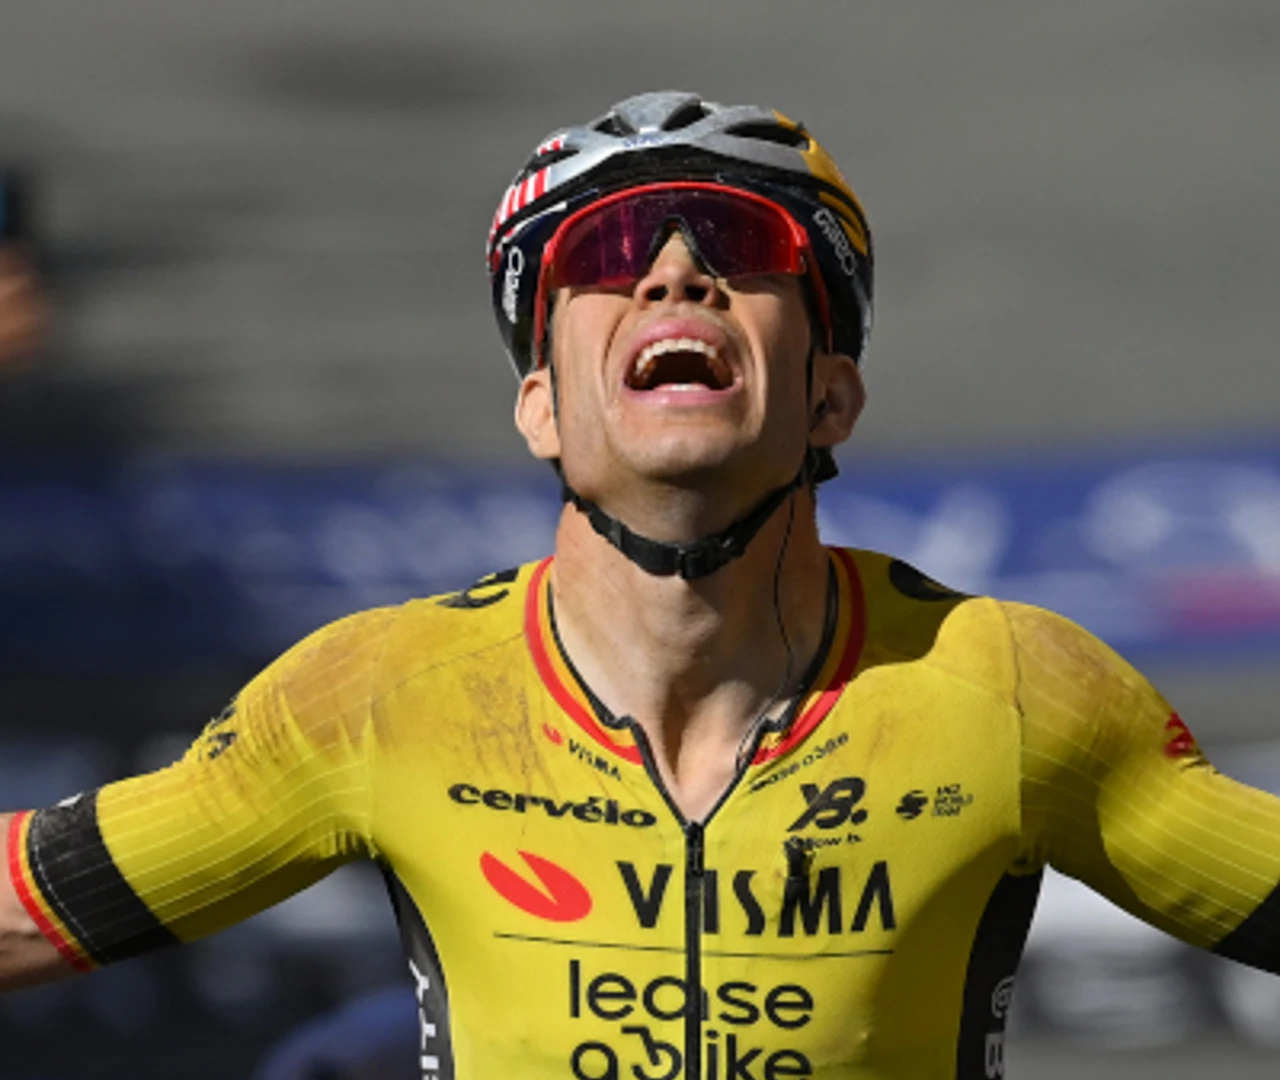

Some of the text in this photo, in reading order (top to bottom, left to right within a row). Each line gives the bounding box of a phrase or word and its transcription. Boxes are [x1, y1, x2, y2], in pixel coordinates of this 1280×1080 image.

[569, 738, 622, 781] VISMA
[448, 783, 657, 827] cervélo
[617, 860, 896, 938] VISMA
[569, 959, 813, 1029] lease
